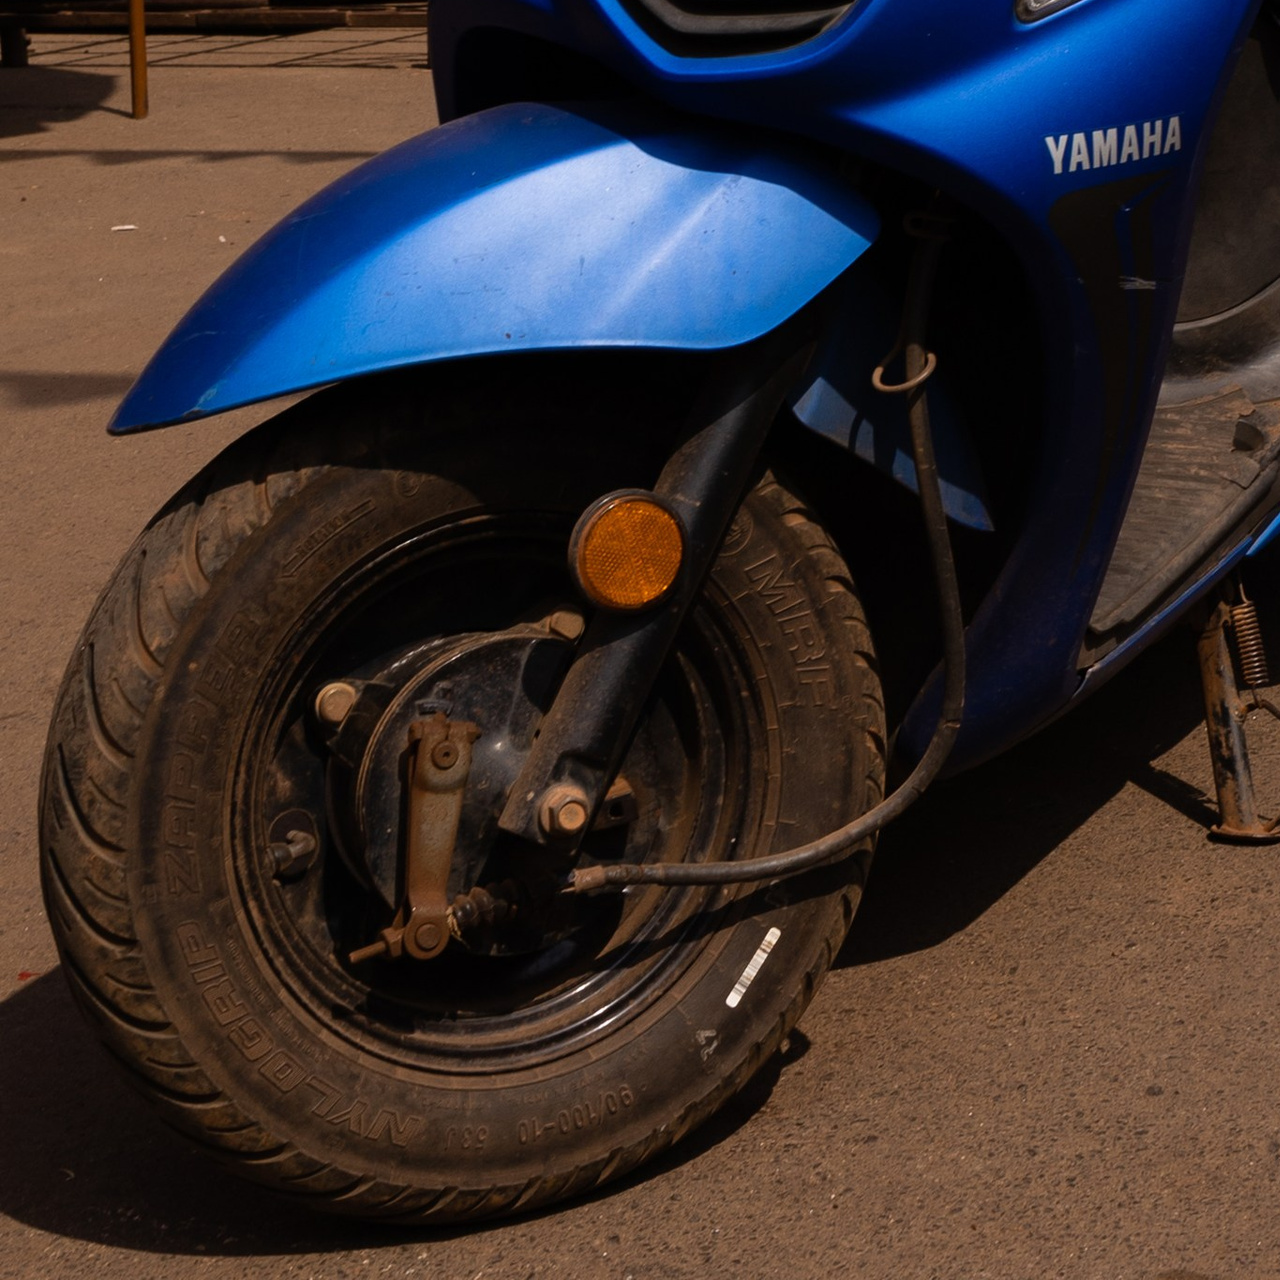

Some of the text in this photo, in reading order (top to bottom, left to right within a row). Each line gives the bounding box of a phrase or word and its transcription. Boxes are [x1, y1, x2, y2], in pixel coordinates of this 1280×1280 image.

[1045, 115, 1182, 175] YAMAHA
[743, 552, 840, 712] MRF
[175, 919, 423, 1148] NYLOGRIP
